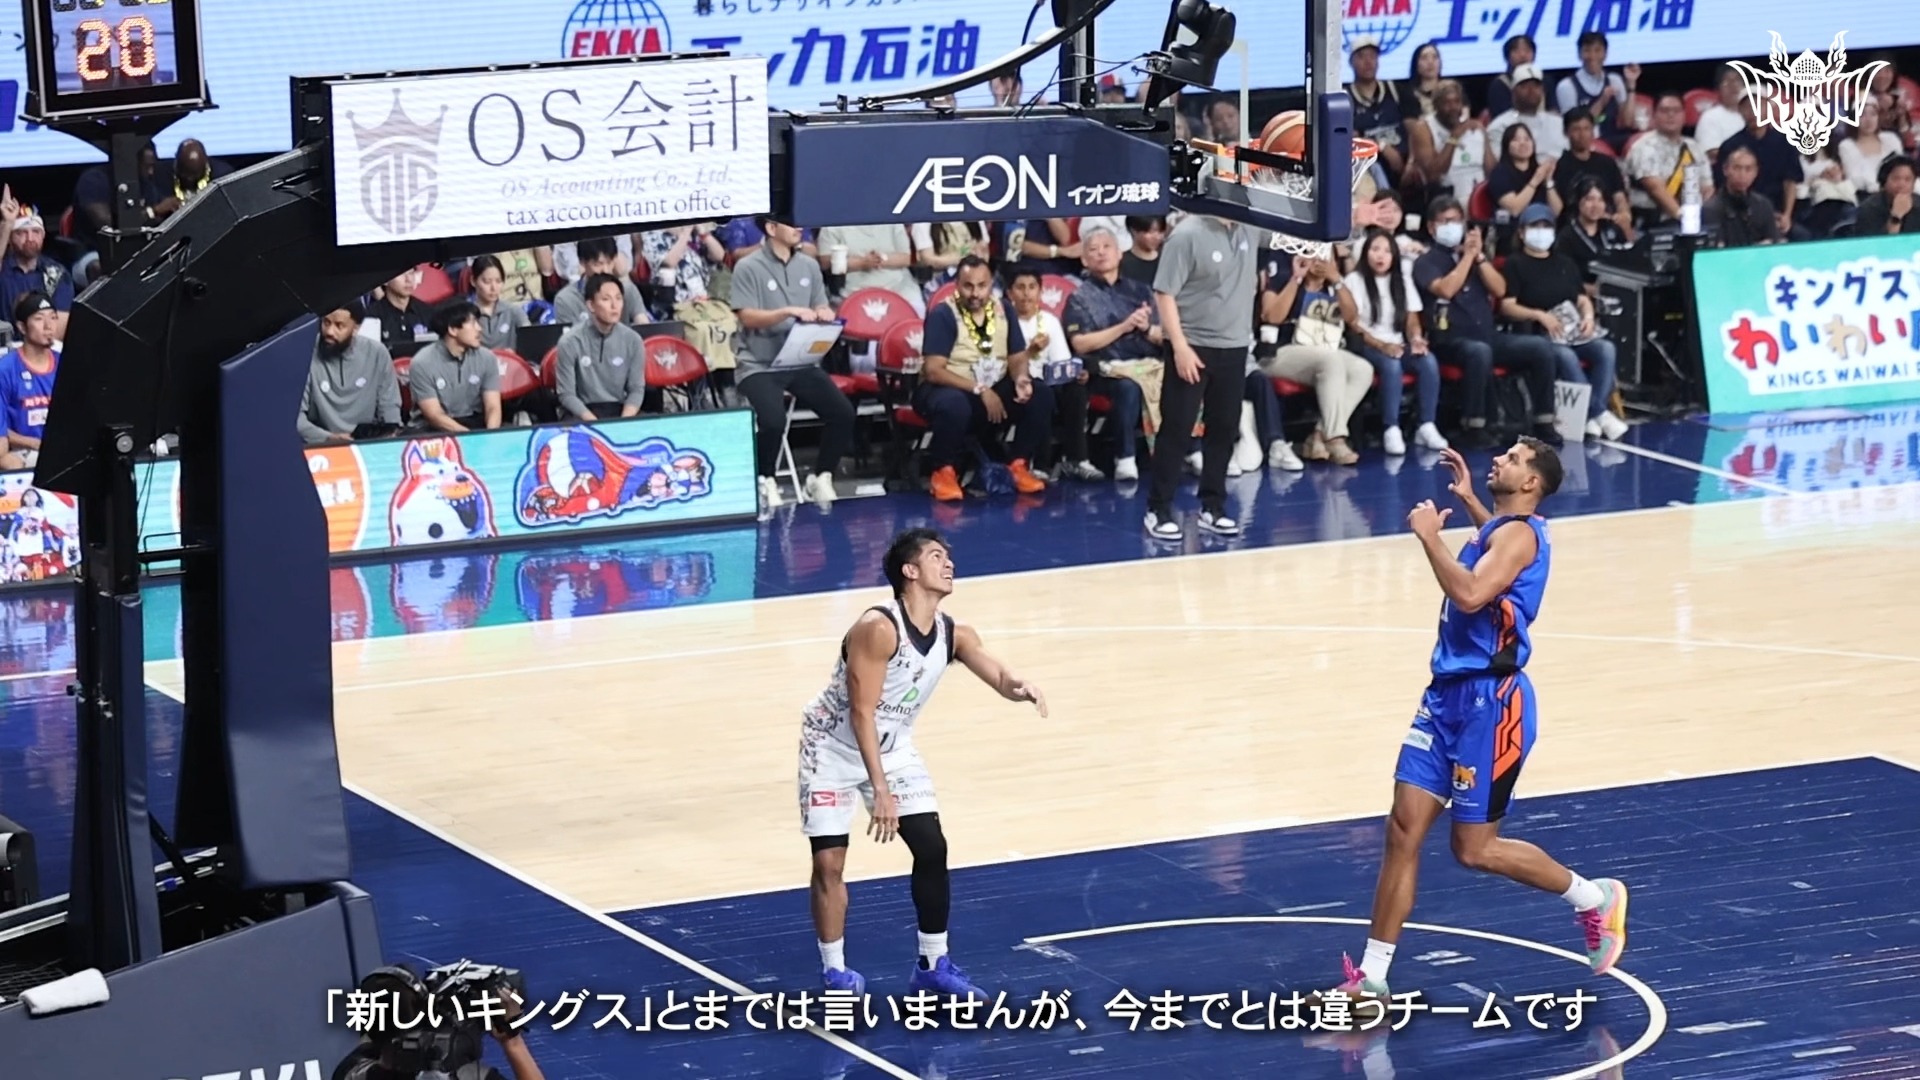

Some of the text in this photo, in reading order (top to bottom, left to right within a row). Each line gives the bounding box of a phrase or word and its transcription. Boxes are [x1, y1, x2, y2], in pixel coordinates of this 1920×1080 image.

[77, 16, 155, 81] 20
[571, 27, 662, 58] EKKA
[691, 20, 980, 87] カ石油
[534, 173, 646, 197] Accounting
[1068, 181, 1160, 206] イオン琉球
[506, 188, 732, 226] tax accountant office
[1774, 266, 1909, 312] キングス
[1728, 309, 1920, 371] わいわい
[1767, 368, 1828, 389] KINGS
[1835, 362, 1909, 383] WAIWAI
